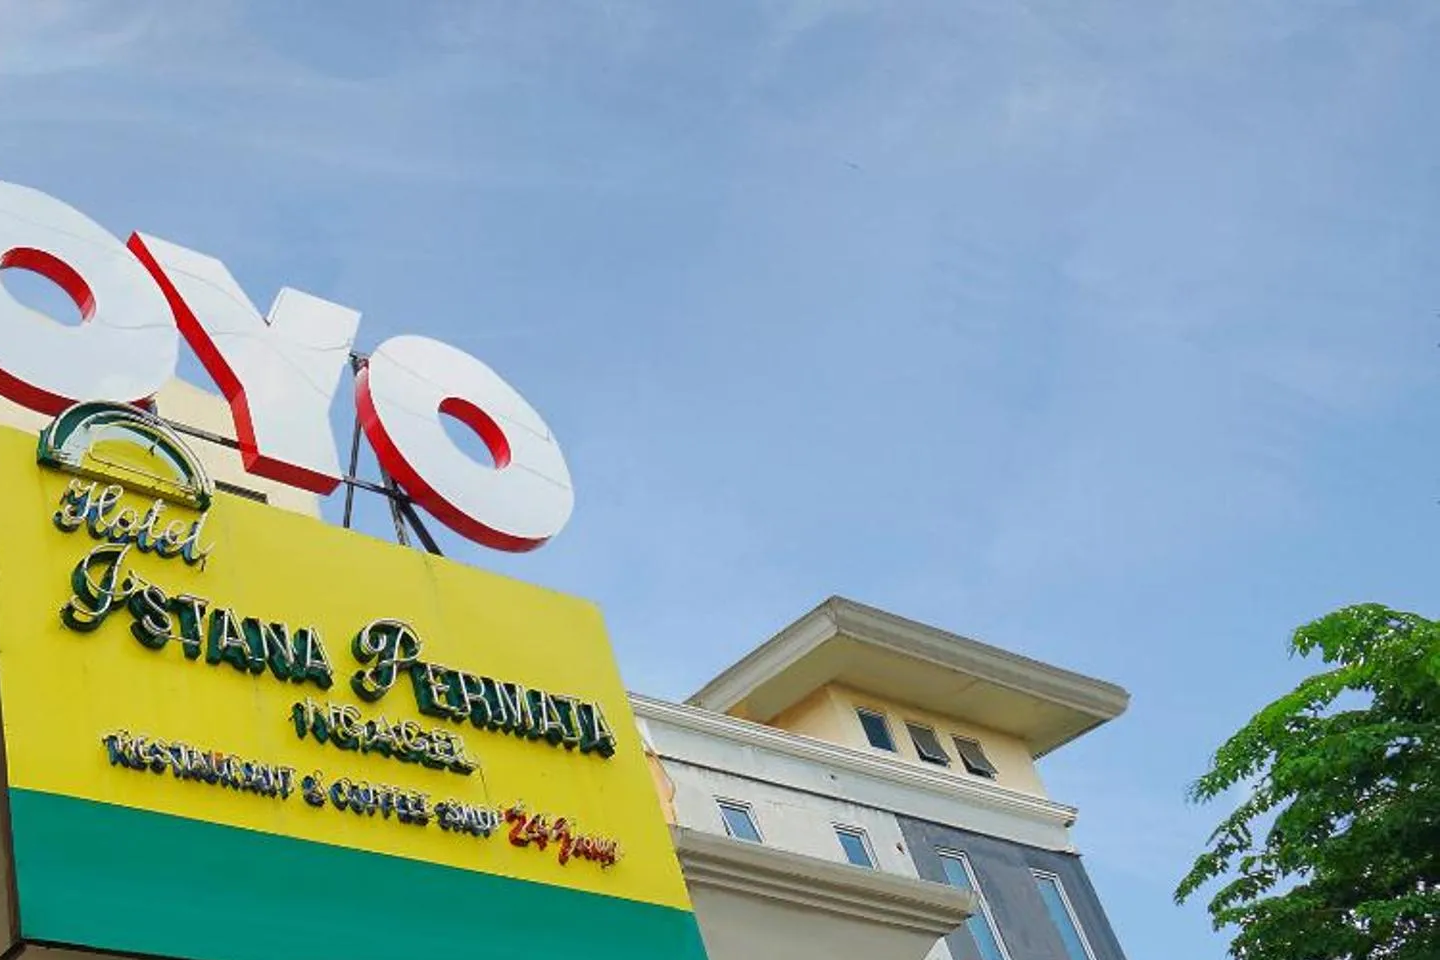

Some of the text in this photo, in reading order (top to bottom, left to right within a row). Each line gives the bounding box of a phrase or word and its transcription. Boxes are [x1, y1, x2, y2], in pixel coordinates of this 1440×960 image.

[53, 478, 215, 566] Hotel
[59, 543, 617, 759] ISTANA PERMATA
[301, 769, 327, 807] &
[434, 799, 500, 838] SHOP
[504, 799, 549, 851] 24
